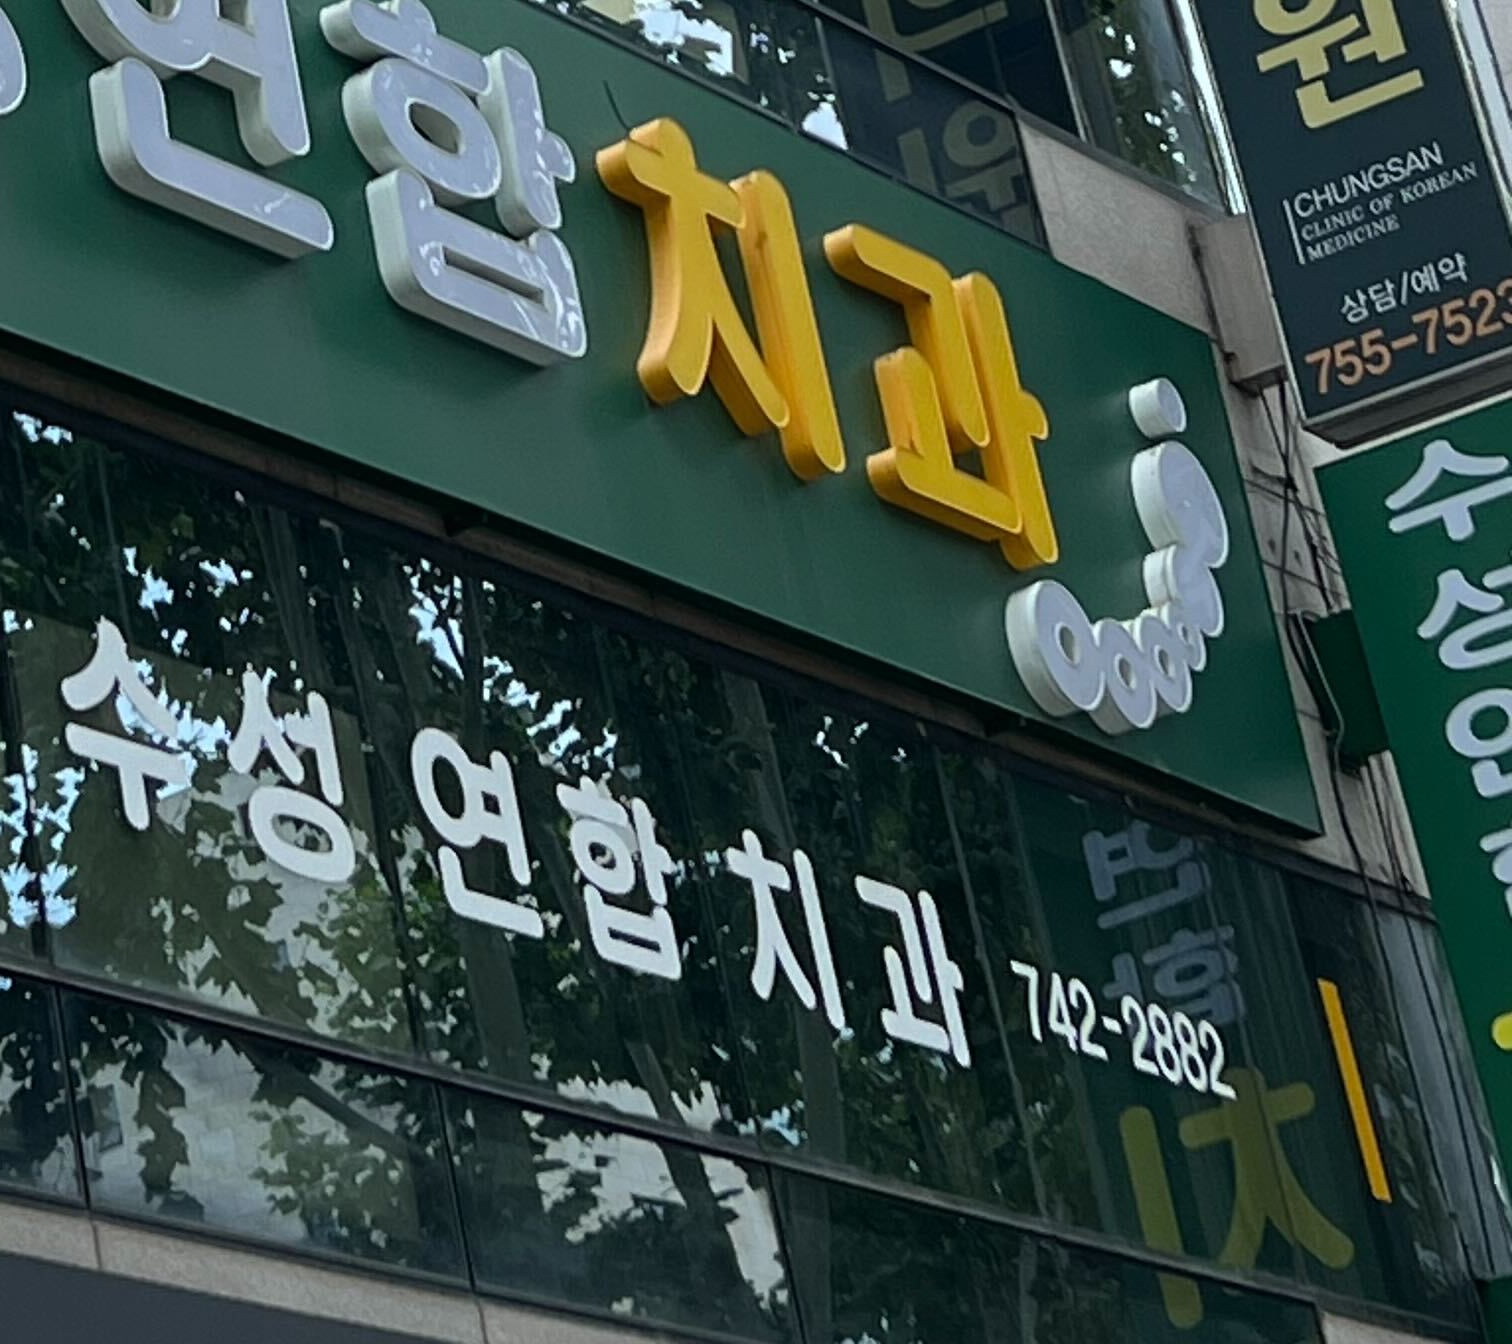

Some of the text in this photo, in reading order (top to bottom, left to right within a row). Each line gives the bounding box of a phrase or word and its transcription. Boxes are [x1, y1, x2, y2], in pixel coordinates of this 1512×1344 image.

[1294, 141, 1444, 217] CHUNGSAN
[1301, 161, 1479, 241] CLINIC OF KOREAN
[1305, 214, 1401, 261] MEDICINE
[1340, 252, 1468, 324] 상담/예약
[61, 614, 1238, 1101] 수성 연합 치과 742-2882
